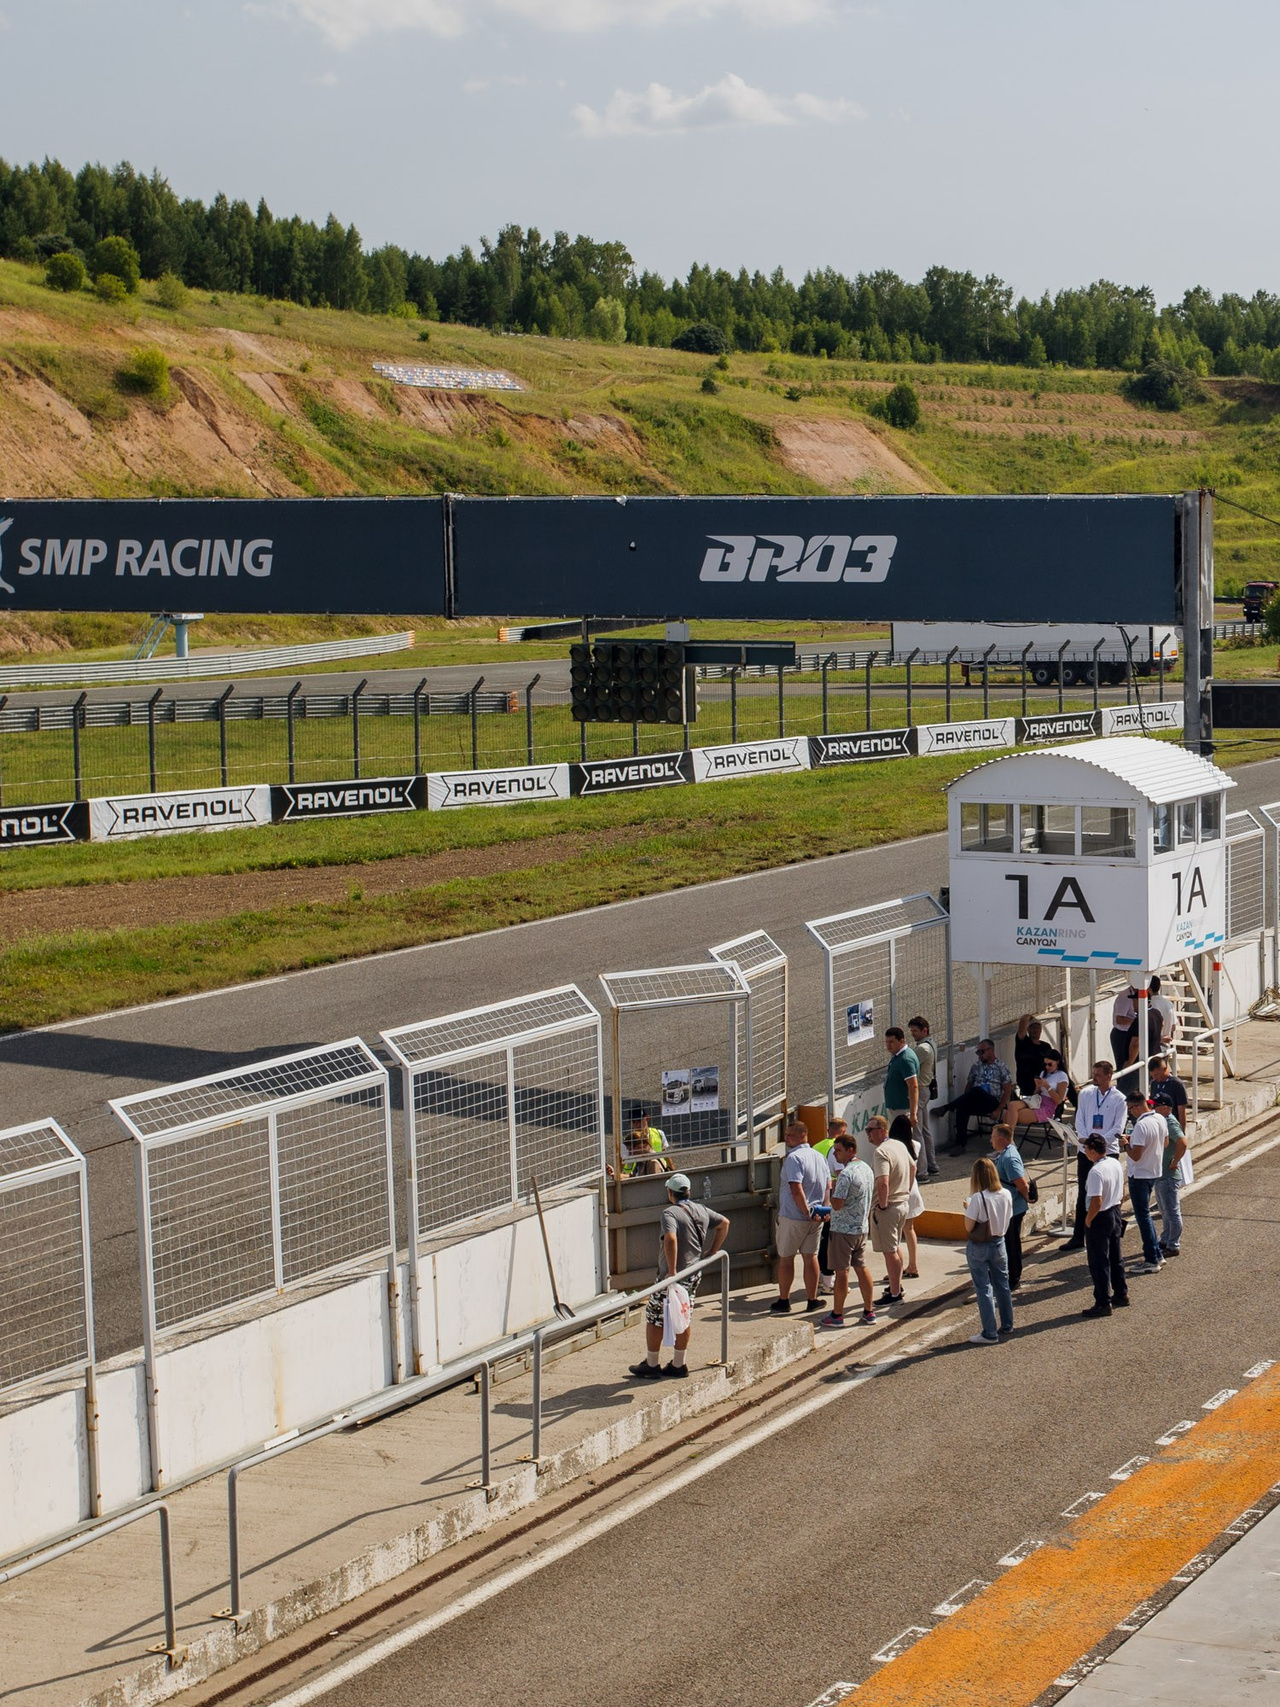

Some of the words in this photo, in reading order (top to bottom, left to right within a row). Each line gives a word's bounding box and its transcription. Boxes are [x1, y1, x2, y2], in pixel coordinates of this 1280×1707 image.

[18, 538, 108, 576] SMP
[115, 539, 274, 577] RACING
[1030, 719, 1089, 736] RAVENOL
[1116, 710, 1170, 727] RAVENOL
[828, 738, 901, 756] RAVENOL
[935, 728, 999, 745] RAVENOL
[714, 748, 791, 769] RAVENOL
[591, 762, 675, 786] RAVENOL
[453, 777, 547, 798] RAVENOL
[297, 787, 404, 811] RAVENOL
[123, 799, 242, 825] RAVENOL
[1004, 873, 1096, 923] 1A
[1171, 866, 1207, 916] 1A
[1016, 926, 1087, 939] KAZANRING
[1016, 937, 1057, 947] CANYON
